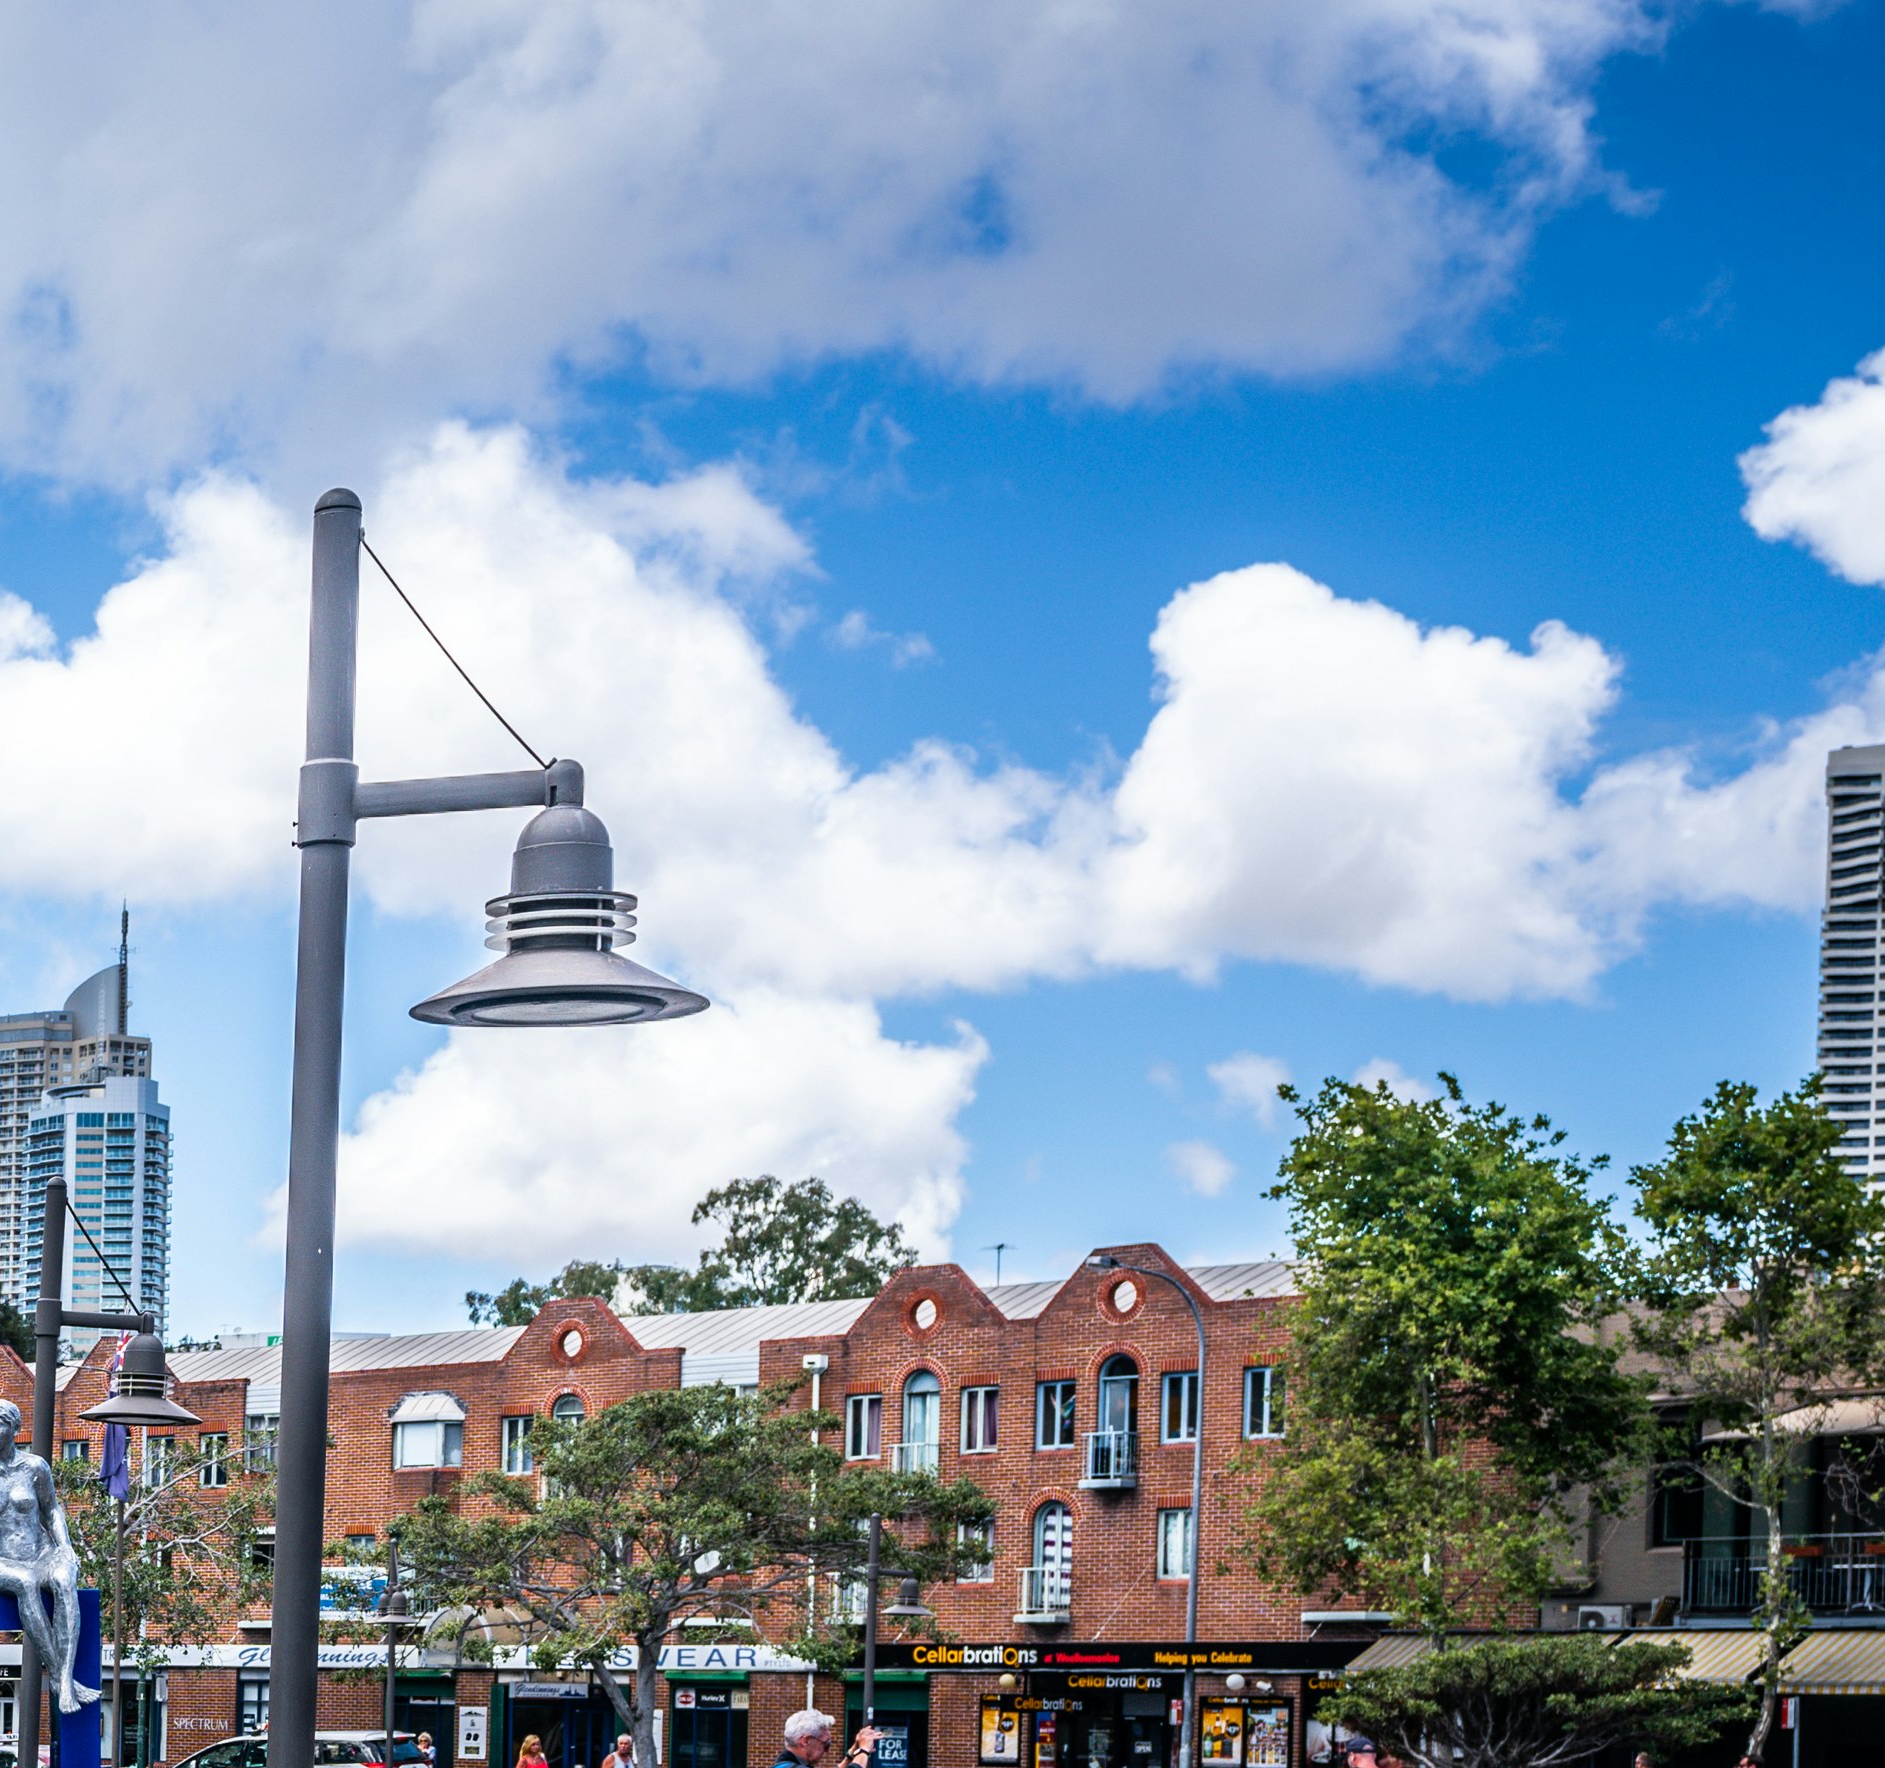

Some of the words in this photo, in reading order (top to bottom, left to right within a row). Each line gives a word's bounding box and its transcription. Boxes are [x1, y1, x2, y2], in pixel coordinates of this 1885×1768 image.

[913, 1646, 1037, 1667] Cellarbrations
[1154, 1651, 1188, 1665] Helping
[1191, 1654, 1207, 1665] you
[1210, 1652, 1252, 1663] Celebrate
[173, 1718, 228, 1730] SPECTRUM
[879, 1739, 902, 1749] FOR
[878, 1750, 907, 1760] LEASE
